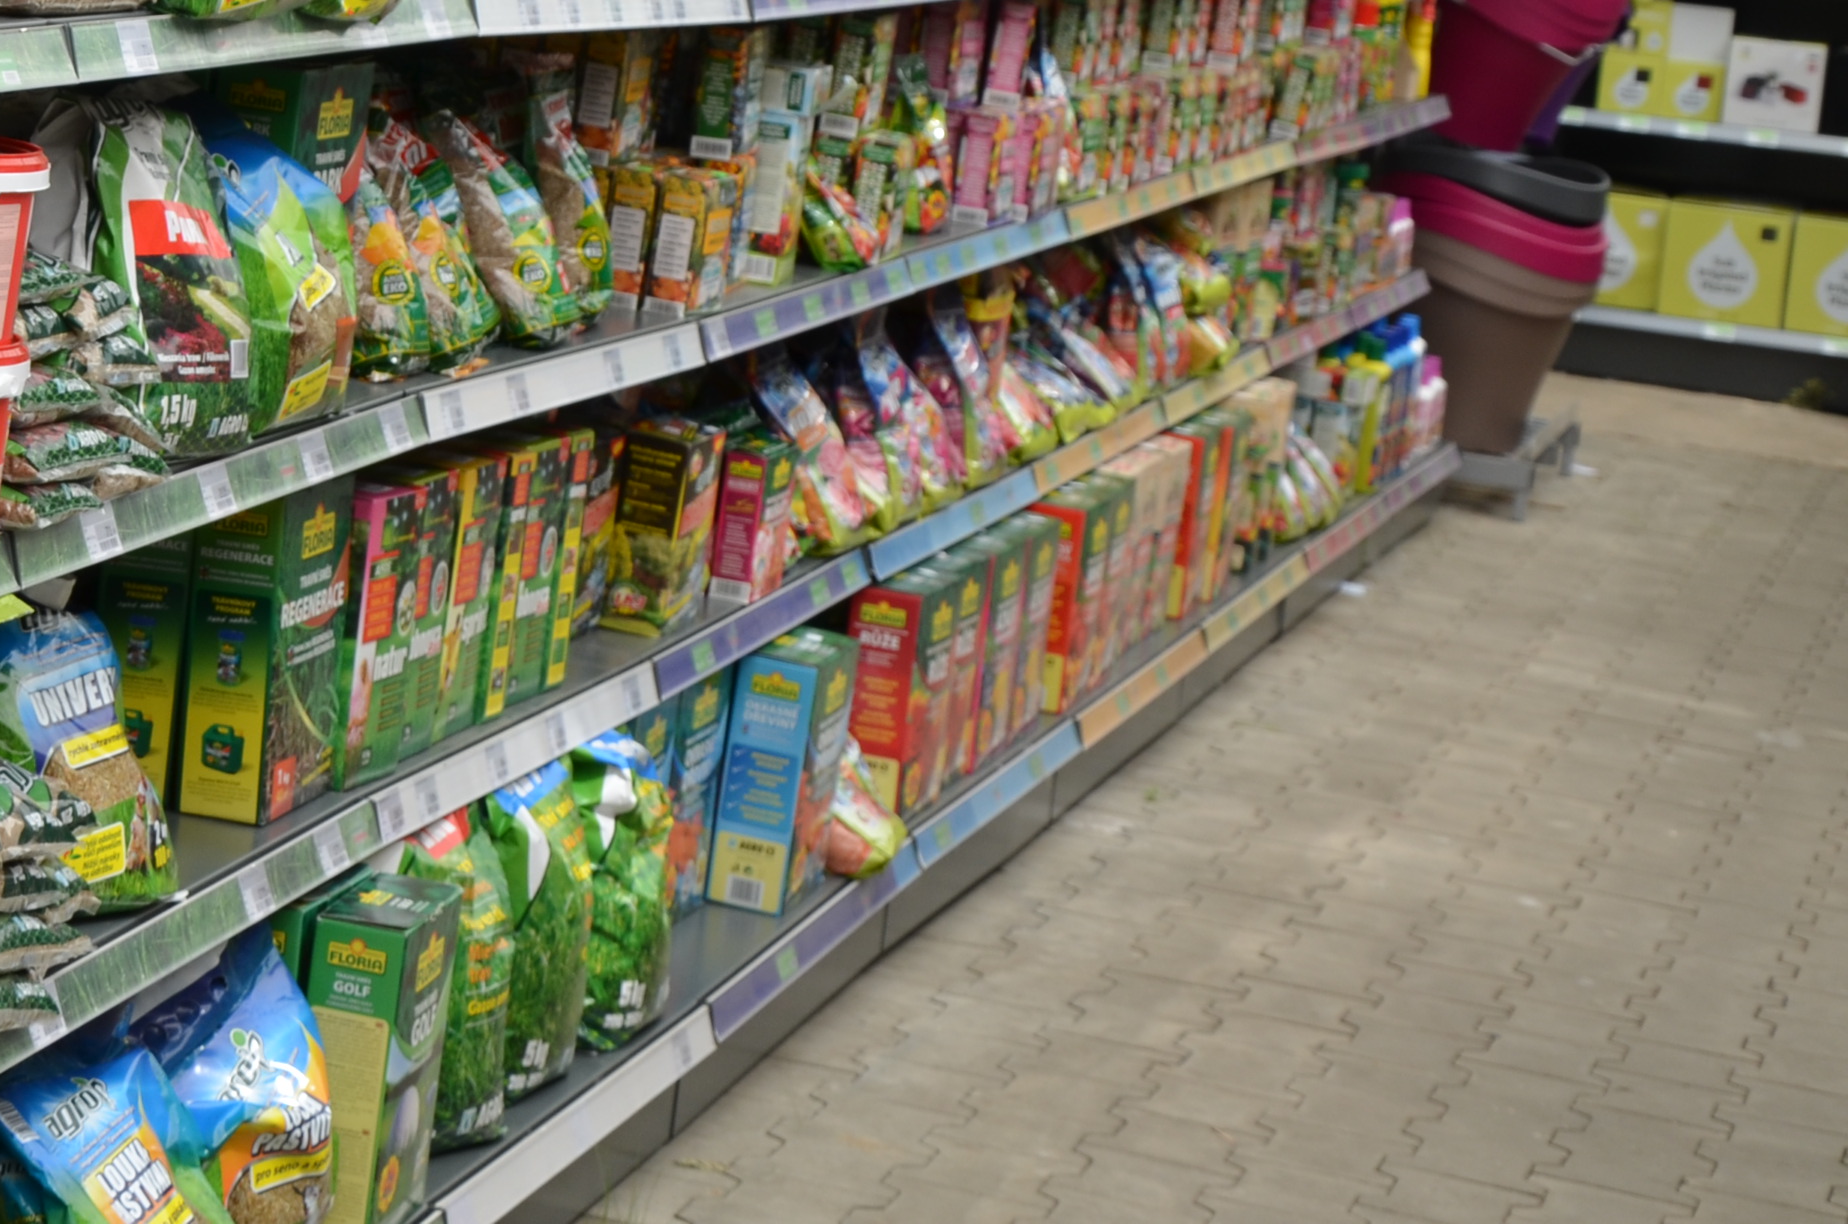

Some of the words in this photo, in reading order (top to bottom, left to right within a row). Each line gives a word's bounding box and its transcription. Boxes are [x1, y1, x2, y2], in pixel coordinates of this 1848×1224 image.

[201, 547, 275, 566] REGENERACE
[281, 585, 345, 628] REGENERACE
[860, 630, 901, 650] RŮŽE
[330, 949, 385, 971] FLORIA
[333, 980, 371, 998] GOLF
